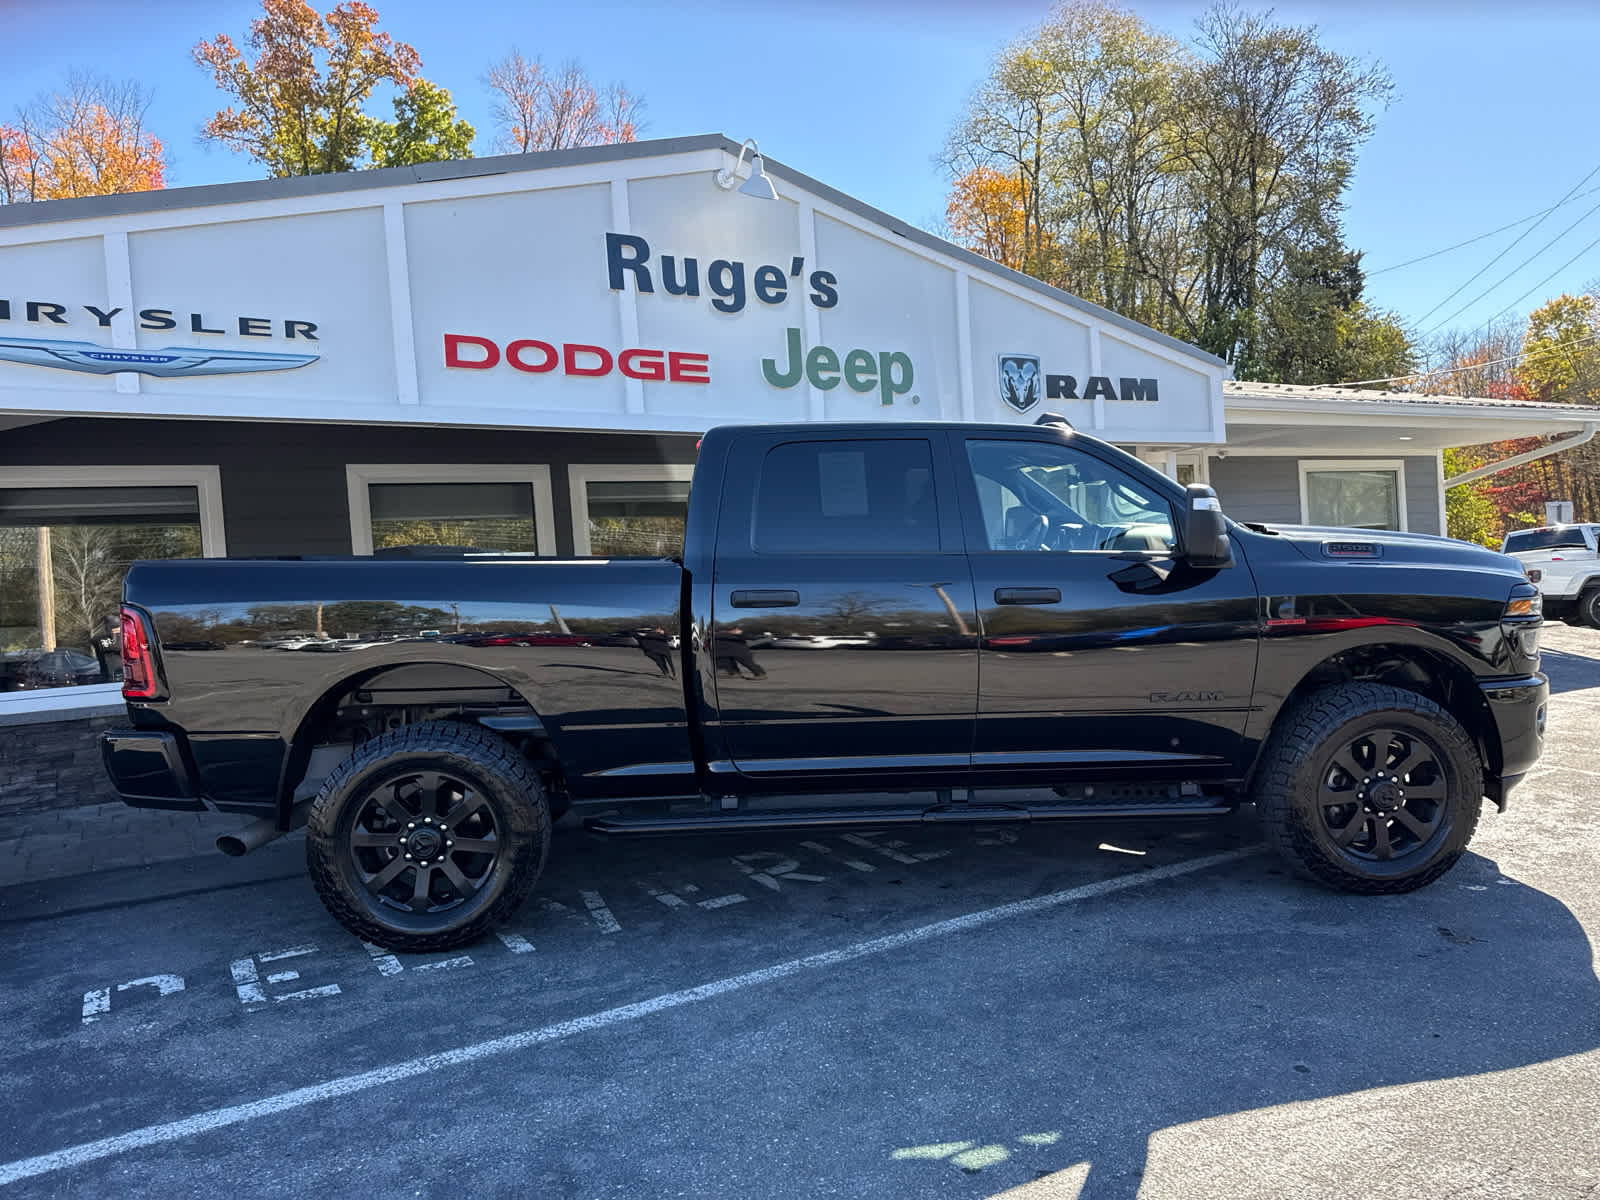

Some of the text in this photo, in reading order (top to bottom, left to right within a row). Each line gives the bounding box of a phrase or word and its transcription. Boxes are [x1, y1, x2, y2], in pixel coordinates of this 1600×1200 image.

[605, 232, 839, 313] Ruge's
[90, 353, 169, 363] CHRYSLER
[444, 333, 710, 383] DODGE
[762, 327, 914, 406] Jeep
[1046, 374, 1159, 401] RAM
[1150, 690, 1225, 702] RAM
